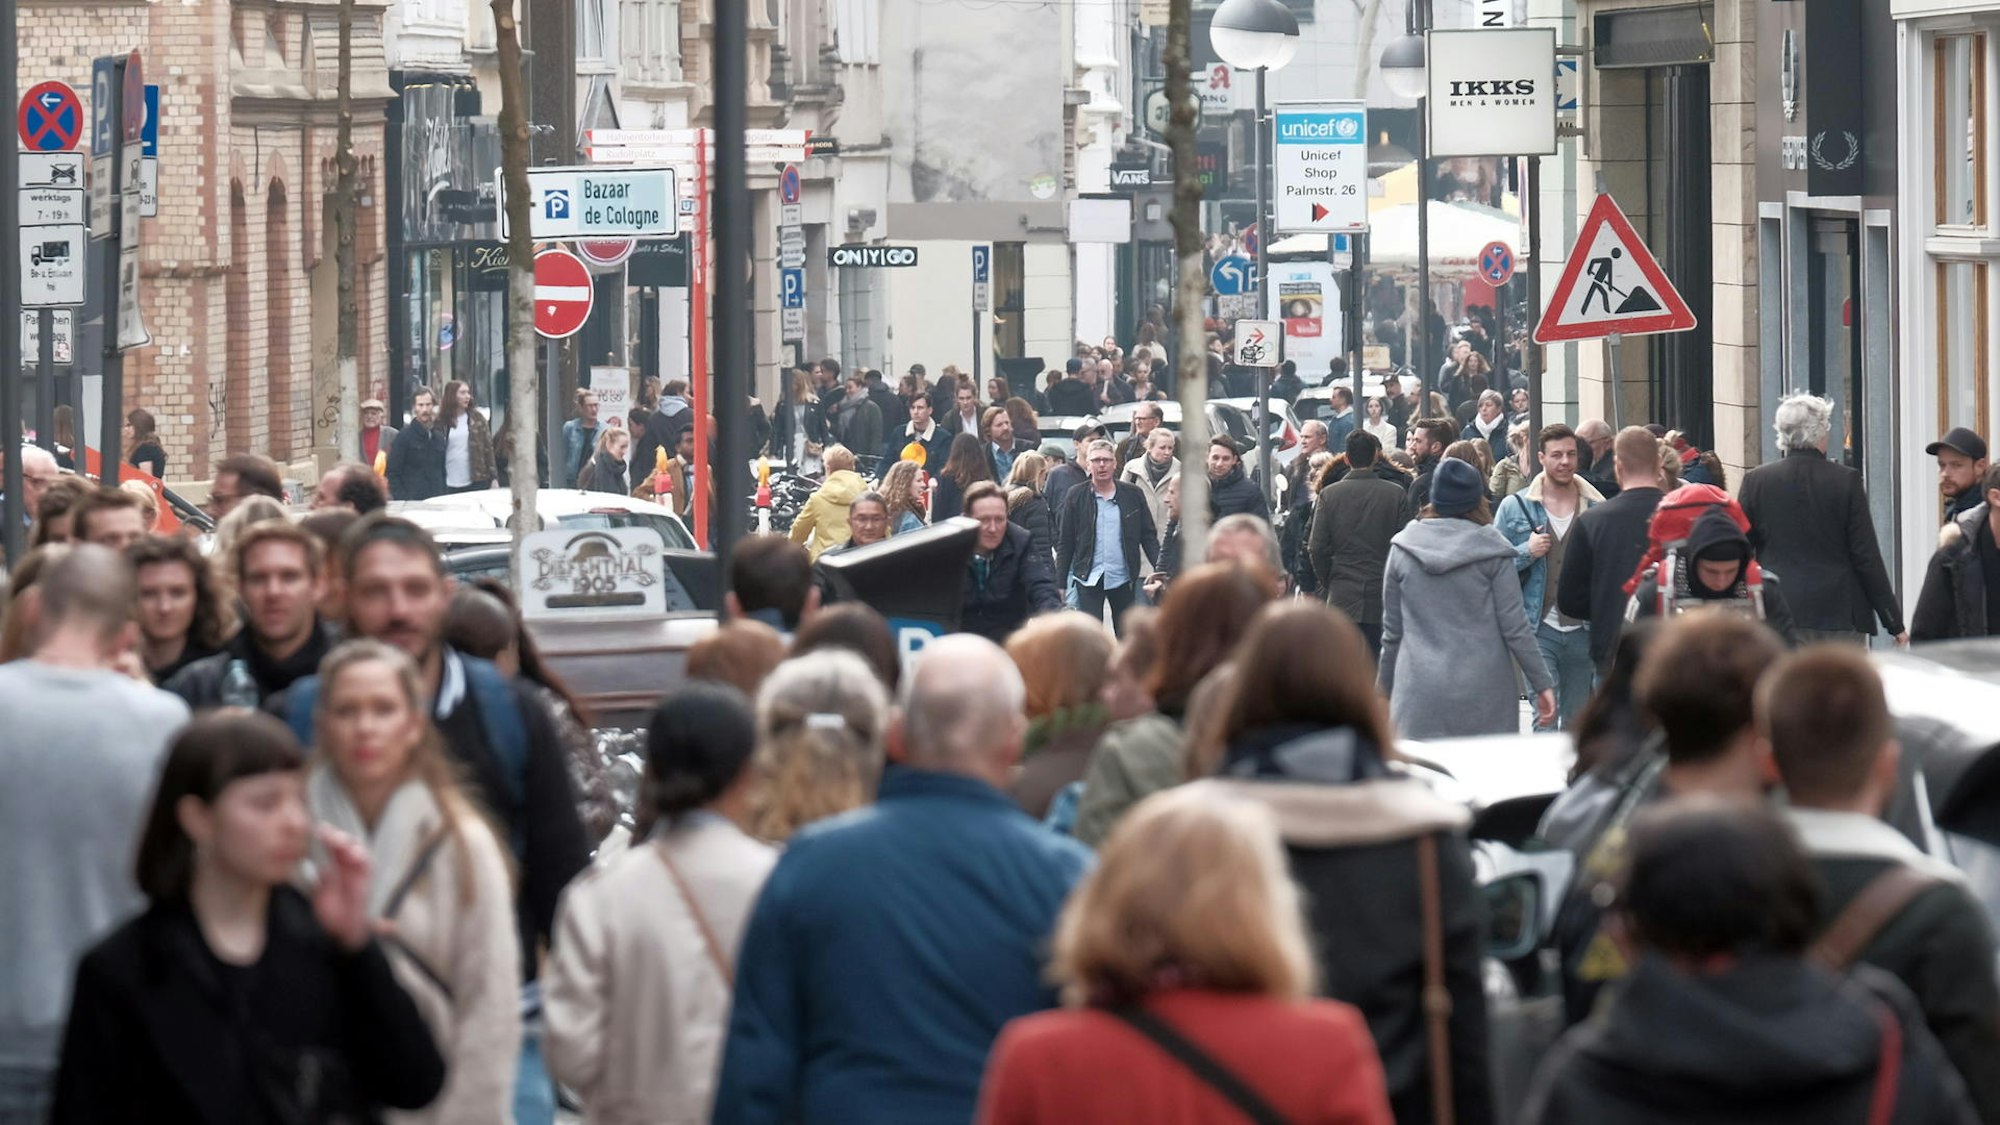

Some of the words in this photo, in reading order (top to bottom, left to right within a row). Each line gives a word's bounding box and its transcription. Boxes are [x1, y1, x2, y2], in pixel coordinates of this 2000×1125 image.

[1450, 79, 1535, 97] IKKS
[1480, 99, 1486, 107] &
[1495, 98, 1536, 106] WOMEN
[1281, 118, 1336, 137] unicef
[1301, 149, 1341, 161] Unicef
[1111, 169, 1150, 184] VANS
[1304, 167, 1337, 180] Shop
[584, 179, 631, 199] Bazaar
[1286, 184, 1337, 196] Palmstr.
[1341, 184, 1357, 196] 26
[31, 194, 72, 204] werktags
[37, 210, 43, 219] 7
[52, 210, 63, 220] 19
[585, 206, 601, 225] de
[606, 206, 659, 230] Cologne
[573, 574, 617, 593] 1905
